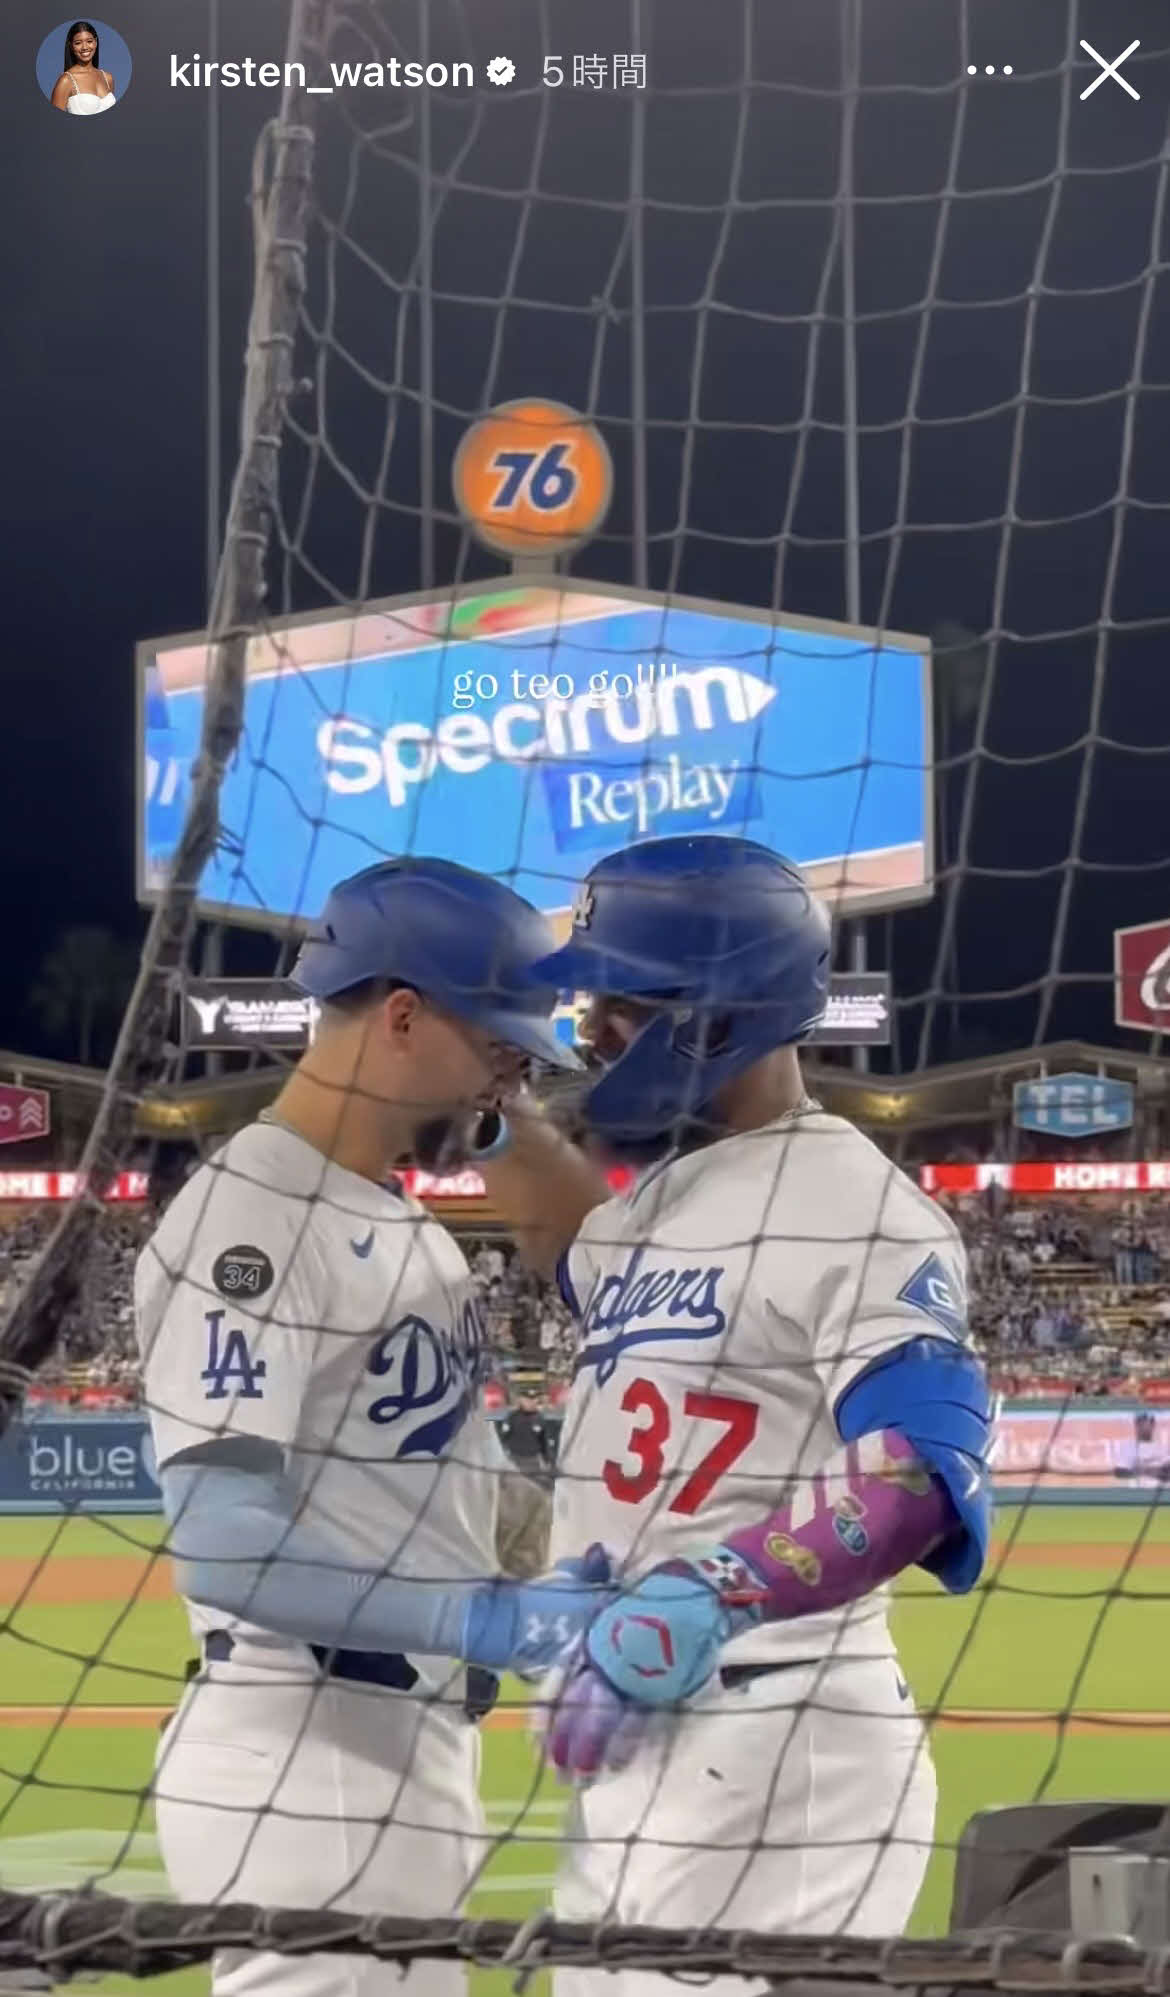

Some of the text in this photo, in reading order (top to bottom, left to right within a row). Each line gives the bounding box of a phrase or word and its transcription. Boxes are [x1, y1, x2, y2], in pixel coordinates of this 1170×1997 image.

[487, 441, 578, 513] 76
[316, 666, 750, 806] Spectrum
[568, 754, 738, 832] Replay
[1029, 1085, 1118, 1124] TEL
[1054, 1163, 1138, 1190] HOME
[223, 1264, 260, 1291] 34
[201, 1309, 266, 1399] LA
[30, 1434, 136, 1477] blue
[603, 1376, 760, 1516] 37
